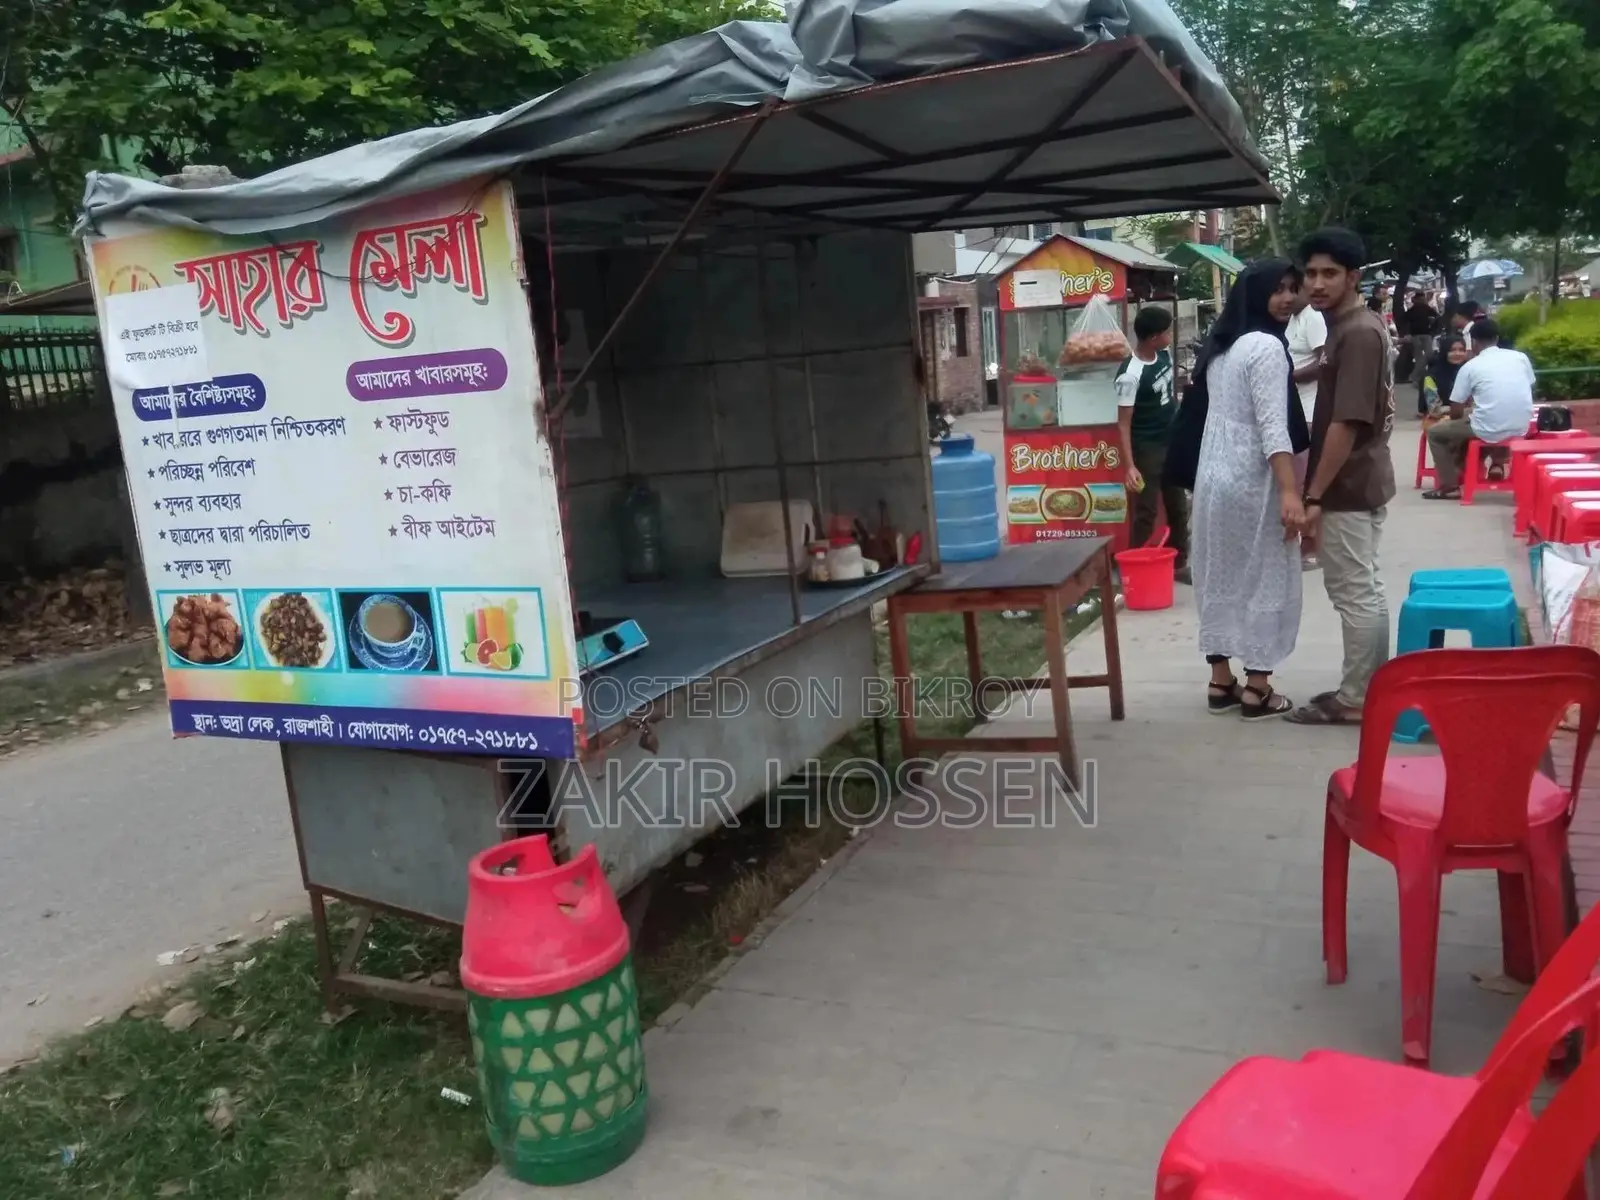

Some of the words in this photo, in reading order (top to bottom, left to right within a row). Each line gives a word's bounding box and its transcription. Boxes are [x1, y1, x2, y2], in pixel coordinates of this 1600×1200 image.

[349, 212, 487, 345] মেলা
[354, 368, 412, 391] আমাদের
[206, 424, 268, 444] গুণগতমান
[270, 416, 347, 440] নিশ্চিতকরণ
[208, 455, 256, 478] পরিবেশ
[393, 448, 457, 468] বেভারেজ
[1010, 440, 1120, 474] Brother's
[397, 478, 452, 504] চা-কফি
[163, 496, 193, 517] সুন্দর
[196, 493, 243, 513] ব্যবহার
[169, 526, 215, 546] ছাত্রদের
[217, 525, 244, 544] দ্বারা
[249, 518, 311, 543] পরিচালিত
[401, 514, 432, 540] বীফ
[436, 513, 497, 540] আইটেম
[174, 559, 204, 580] সুলভ
[206, 559, 232, 581] মূল্য
[219, 714, 244, 734] ভদ্রা
[418, 725, 539, 750] ০১৭৫৭-২৭১৮৮১
